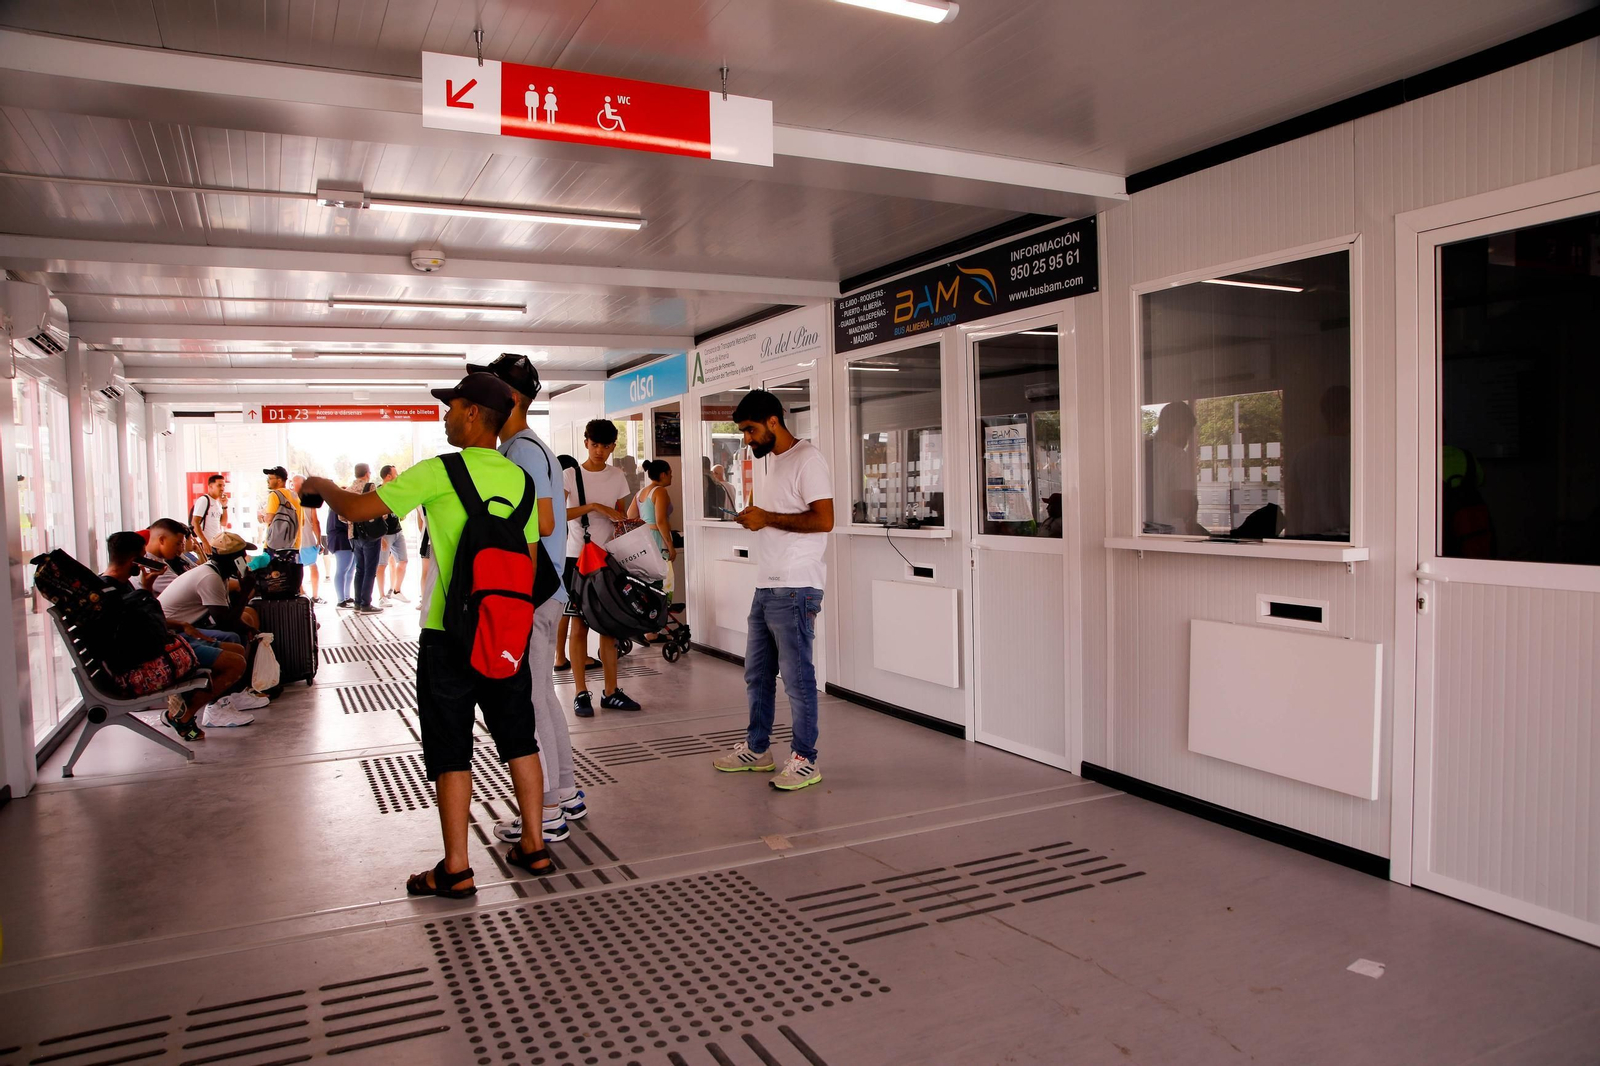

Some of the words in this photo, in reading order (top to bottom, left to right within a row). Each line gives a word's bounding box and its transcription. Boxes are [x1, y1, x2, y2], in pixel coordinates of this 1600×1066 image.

[617, 95, 631, 105] WC
[1010, 231, 1080, 262] INFORMACIÓN
[1010, 263, 1030, 281] 950
[1032, 258, 1047, 275] 25
[1048, 253, 1063, 271] 95
[1066, 248, 1080, 266] 61
[840, 302, 845, 310] EL
[845, 297, 858, 308] EJIDO
[860, 289, 884, 303] ROQUETAS
[894, 275, 960, 324] BAM
[1008, 276, 1084, 302] www.busbam.com
[840, 317, 856, 328] GUADIX
[858, 308, 887, 322] VALDEPEÑAS
[843, 306, 860, 318] PUERTO
[862, 299, 882, 312] ALMERÍA
[848, 321, 878, 335] MANZANARES
[894, 326, 905, 336] BUS
[905, 318, 930, 333] ALMERÍA
[933, 313, 957, 326] MADRID
[760, 336, 773, 358] R.
[775, 330, 792, 355] del
[791, 325, 819, 350] Pino
[853, 331, 875, 345] MADRID
[630, 374, 654, 402] alsa
[269, 409, 286, 420] D1
[294, 408, 309, 420] 23
